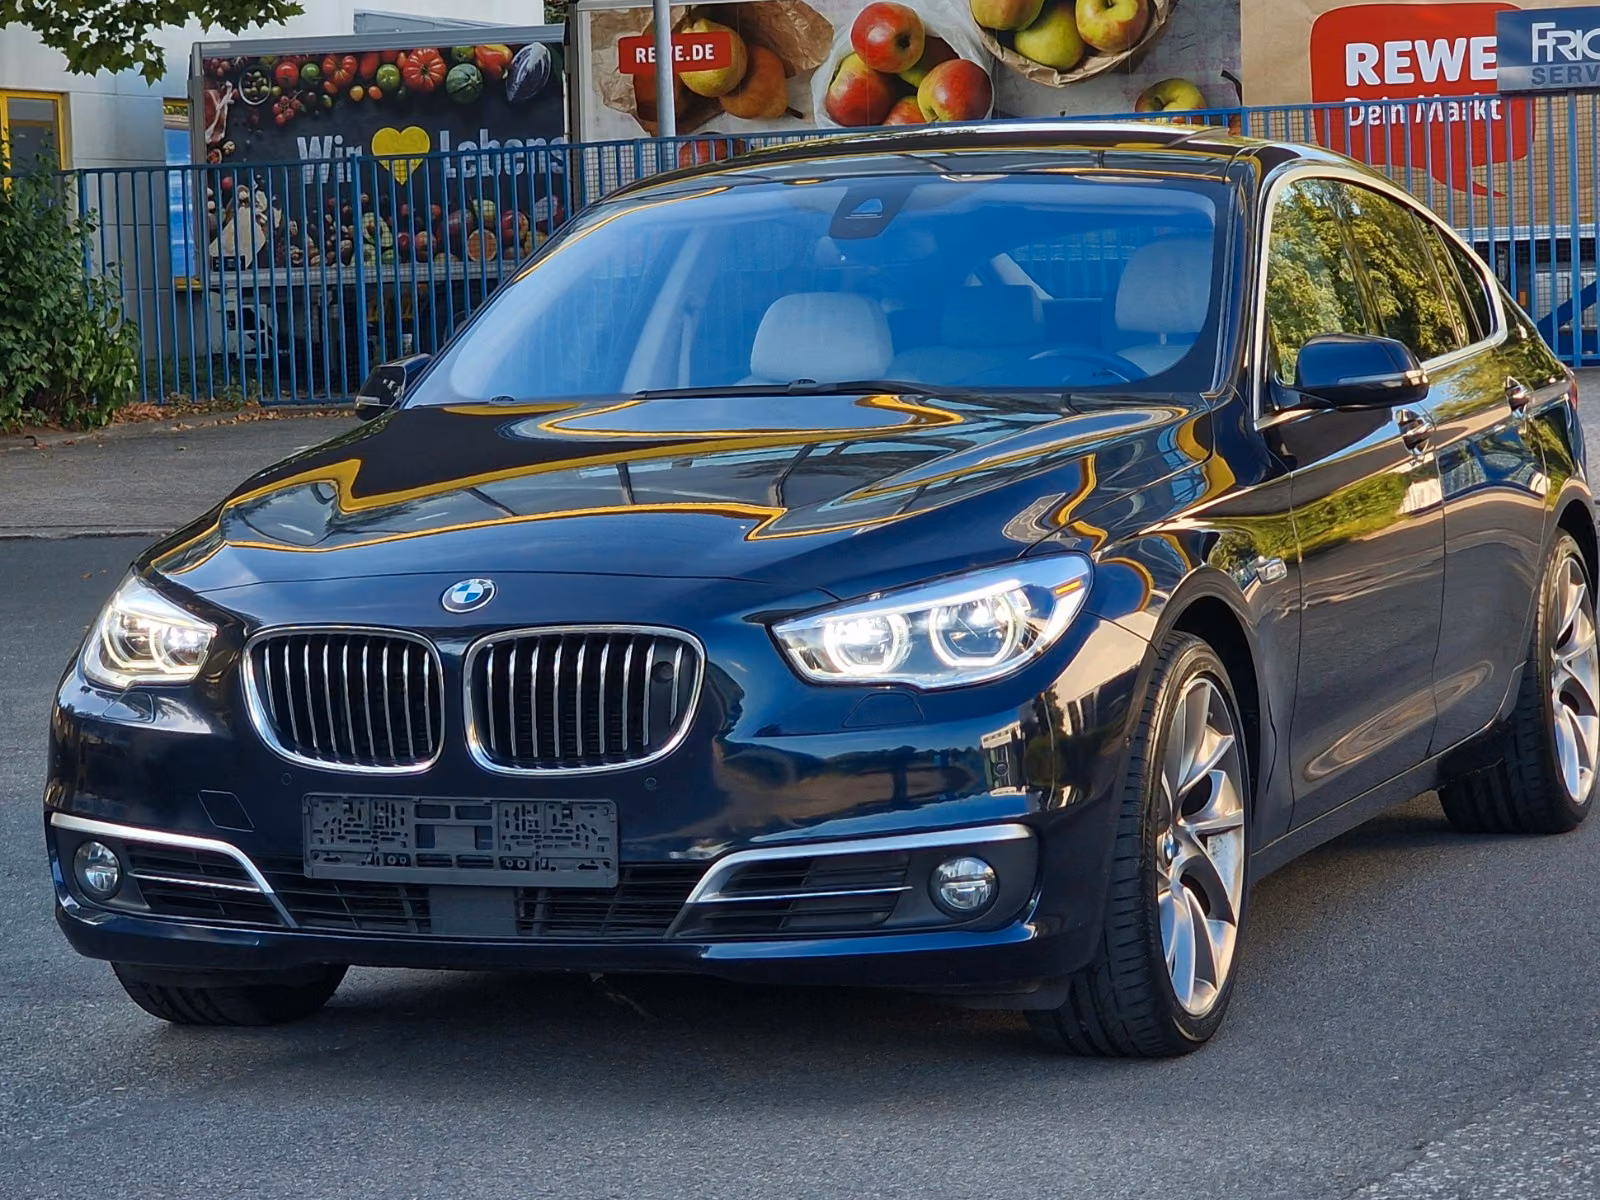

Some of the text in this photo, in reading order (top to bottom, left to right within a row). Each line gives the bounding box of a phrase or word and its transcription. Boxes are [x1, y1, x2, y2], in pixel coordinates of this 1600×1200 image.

[635, 43, 715, 63] REE.DE
[1345, 36, 1497, 86] REWE
[1345, 92, 1502, 126] Dein Markt
[296, 135, 363, 184] Wir
